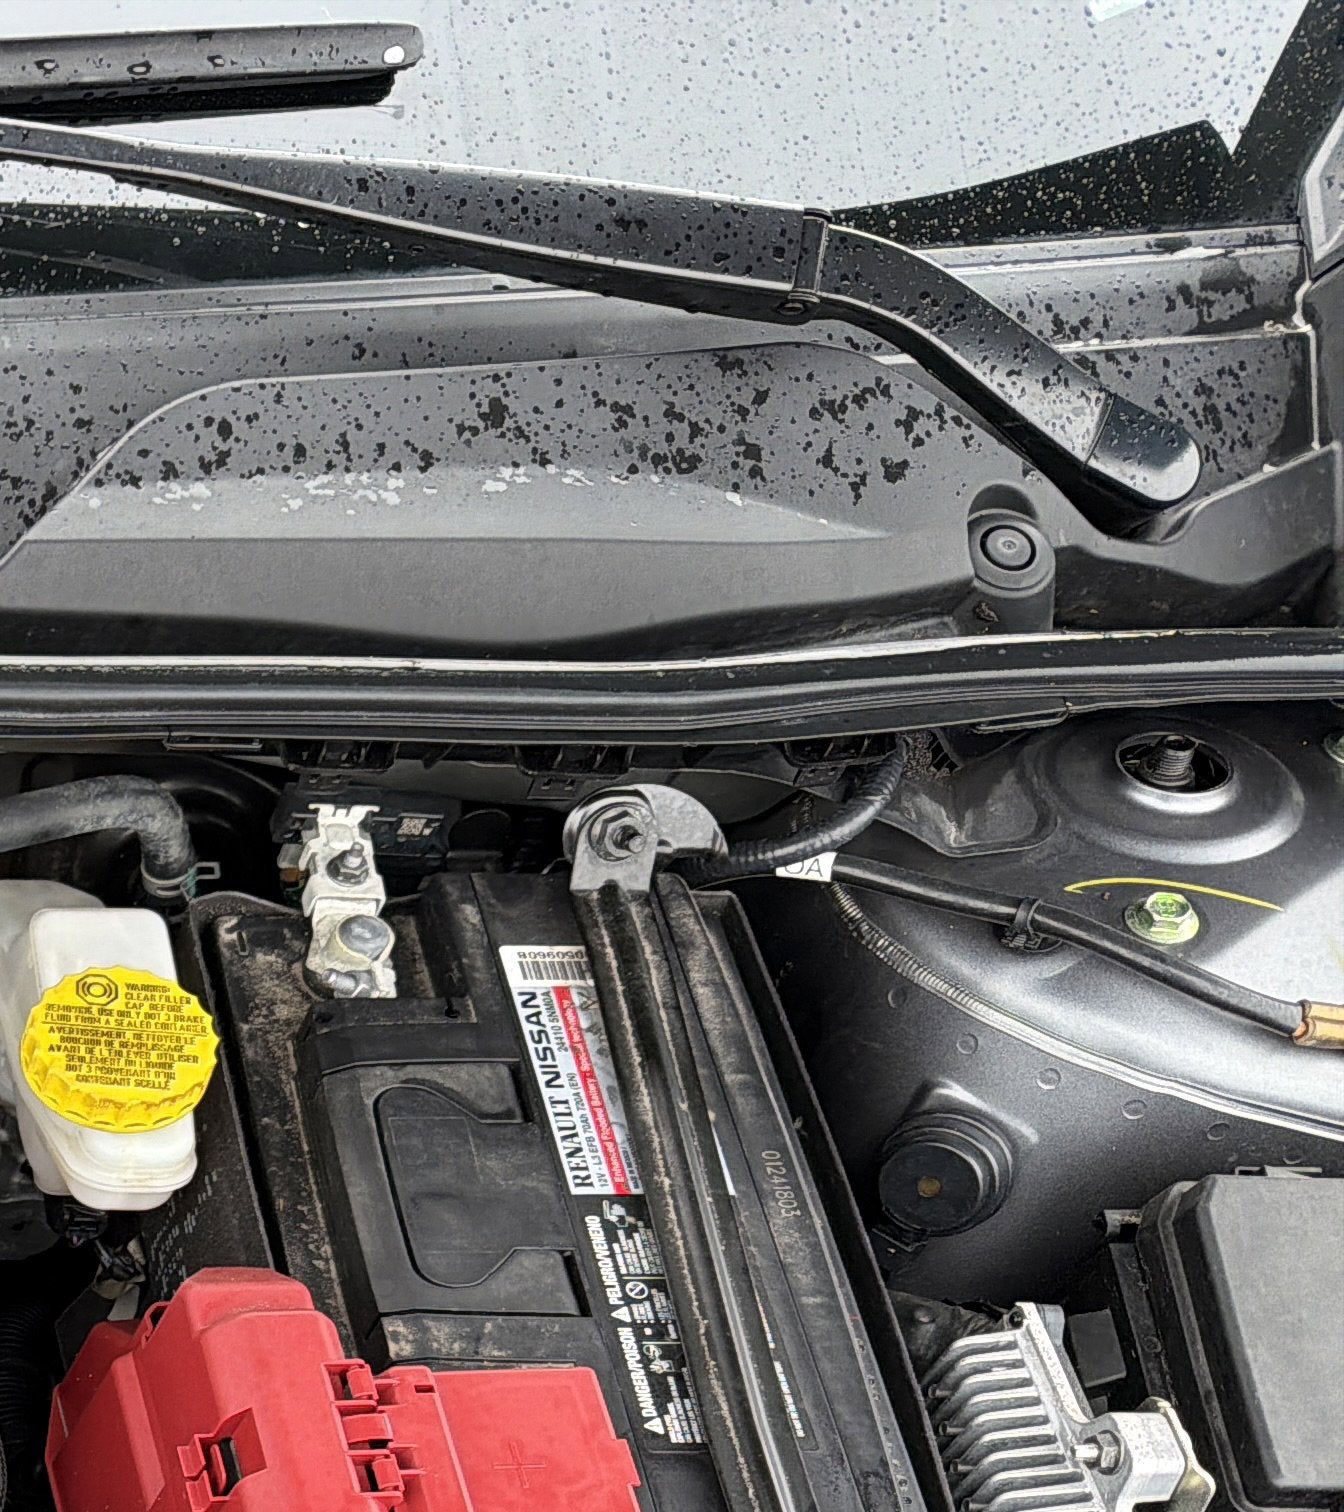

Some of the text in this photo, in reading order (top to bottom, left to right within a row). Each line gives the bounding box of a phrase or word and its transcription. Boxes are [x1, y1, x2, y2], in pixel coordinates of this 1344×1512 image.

[125, 992, 192, 1005] CLEAR FILLER
[98, 1007, 113, 1017] USE
[116, 1009, 141, 1020] ONLY
[144, 1012, 161, 1021] DOT
[164, 1013, 171, 1022] 3
[173, 1014, 205, 1024] BRAKE
[125, 1002, 184, 1014] CAP BEFORE
[44, 1012, 72, 1022] FLUID
[74, 1015, 102, 1025] FROM
[104, 1017, 111, 1026] A
[114, 1018, 151, 1029] SEALED
[85, 1047, 96, 1055] DE
[104, 1039, 116, 1048] DE
[65, 1064, 83, 1073] DOT
[86, 1065, 92, 1074] 3
[517, 991, 596, 1190] RENAULT NISSAN
[567, 1073, 582, 1092] (EN)
[588, 1080, 604, 1112] Battery
[580, 1113, 595, 1139] 70Ah
[597, 1113, 613, 1143] Flooded
[586, 1142, 599, 1157] EFB
[605, 1145, 625, 1182] Enhanced
[584, 1215, 624, 1305] PELIGRO/VENENO
[617, 1327, 657, 1417] DANGER/POISON
